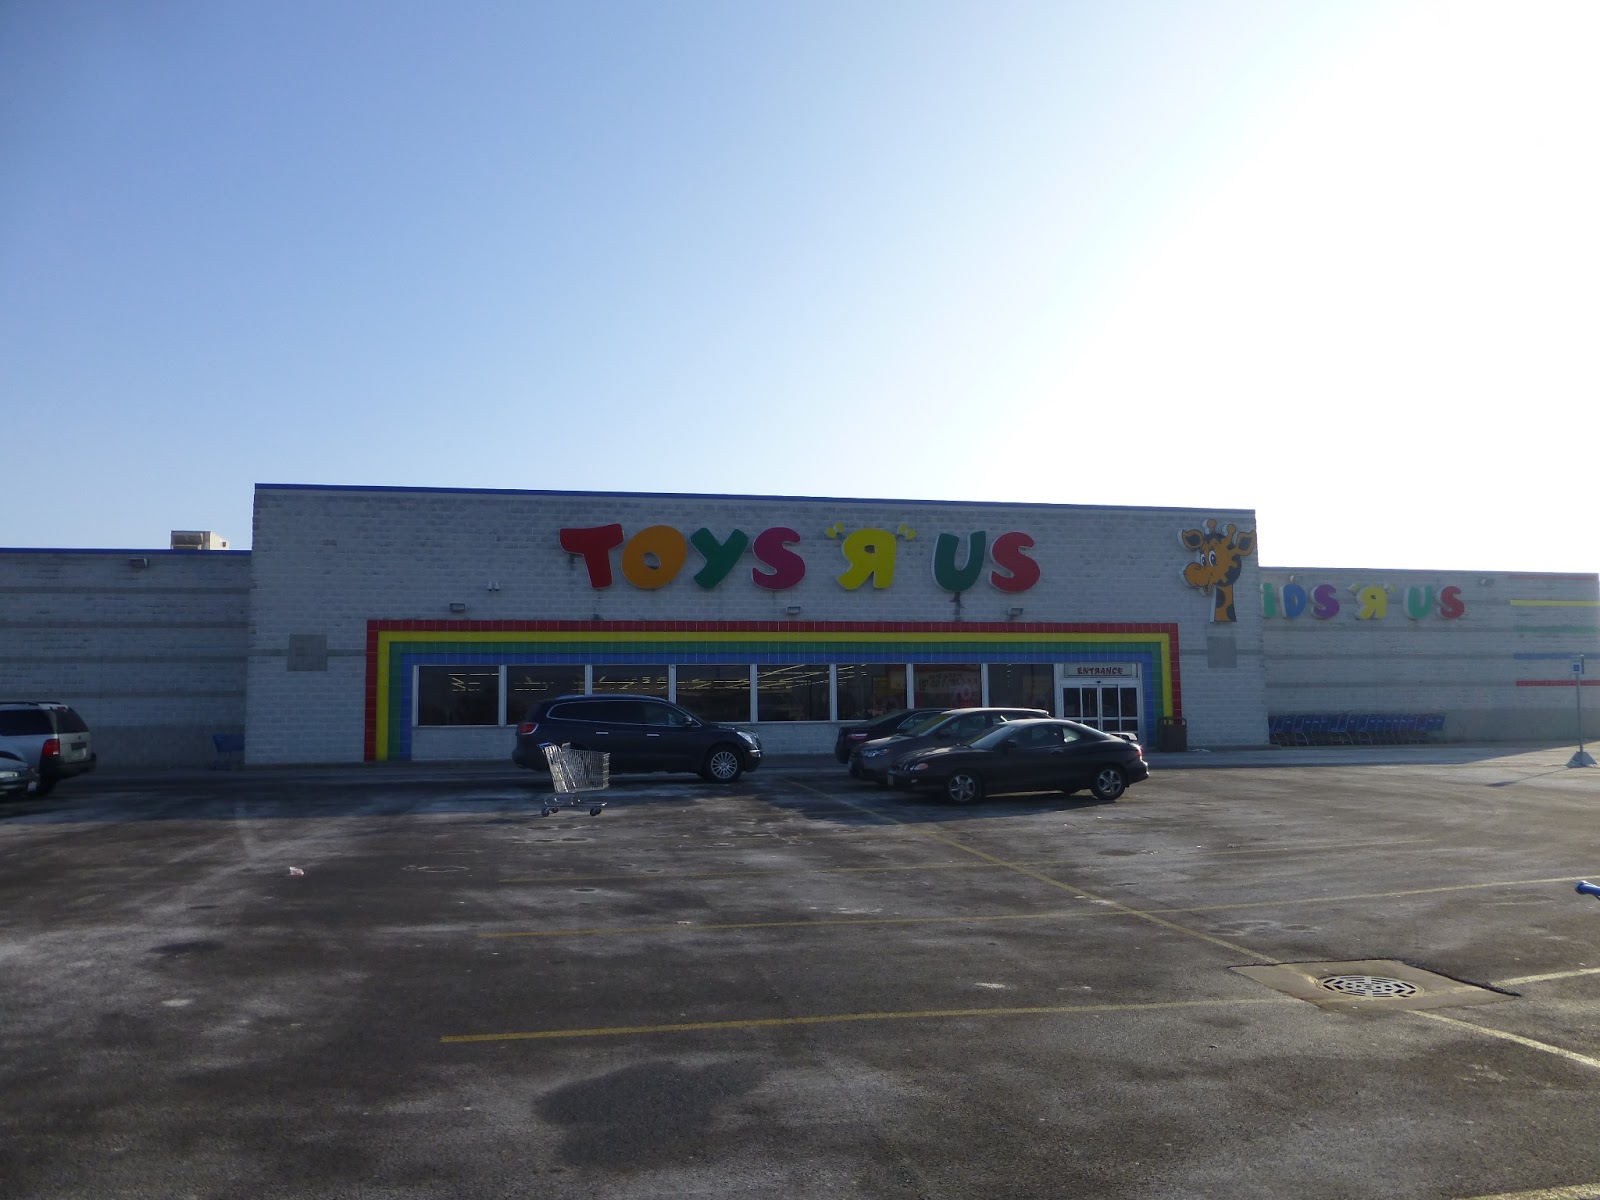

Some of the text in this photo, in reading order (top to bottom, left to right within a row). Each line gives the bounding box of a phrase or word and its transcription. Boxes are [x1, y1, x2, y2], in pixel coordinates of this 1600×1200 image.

[560, 523, 806, 590] TOYS
[932, 531, 1040, 593] US
[1404, 584, 1465, 619] US
[1077, 666, 1123, 675] ENTRANCE
